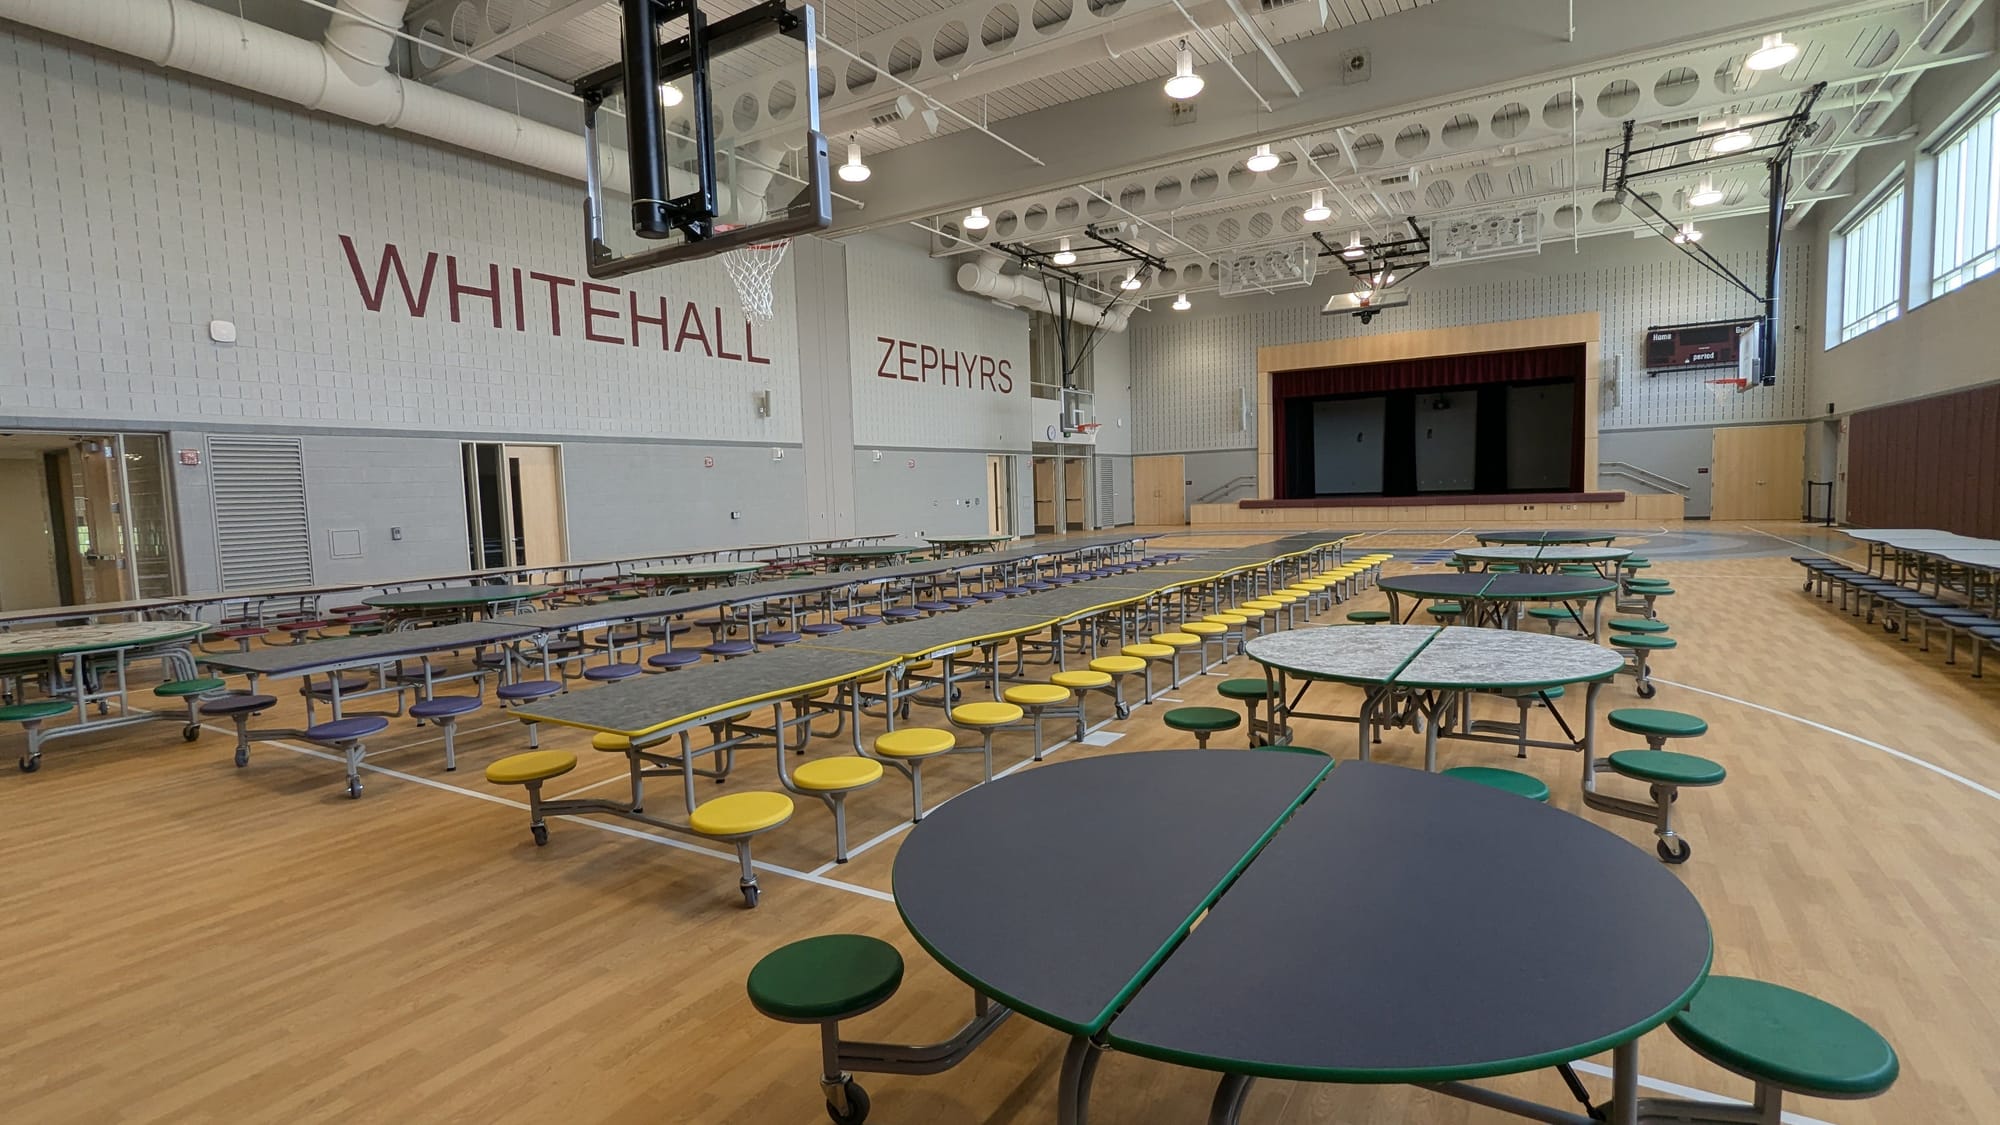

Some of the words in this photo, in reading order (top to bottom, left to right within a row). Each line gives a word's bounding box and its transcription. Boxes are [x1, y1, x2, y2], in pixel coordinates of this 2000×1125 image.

[338, 234, 770, 365] WHITEHALL
[1653, 333, 1672, 341] Home
[877, 336, 1013, 394] ZEPHYRS
[1693, 352, 1715, 361] period
